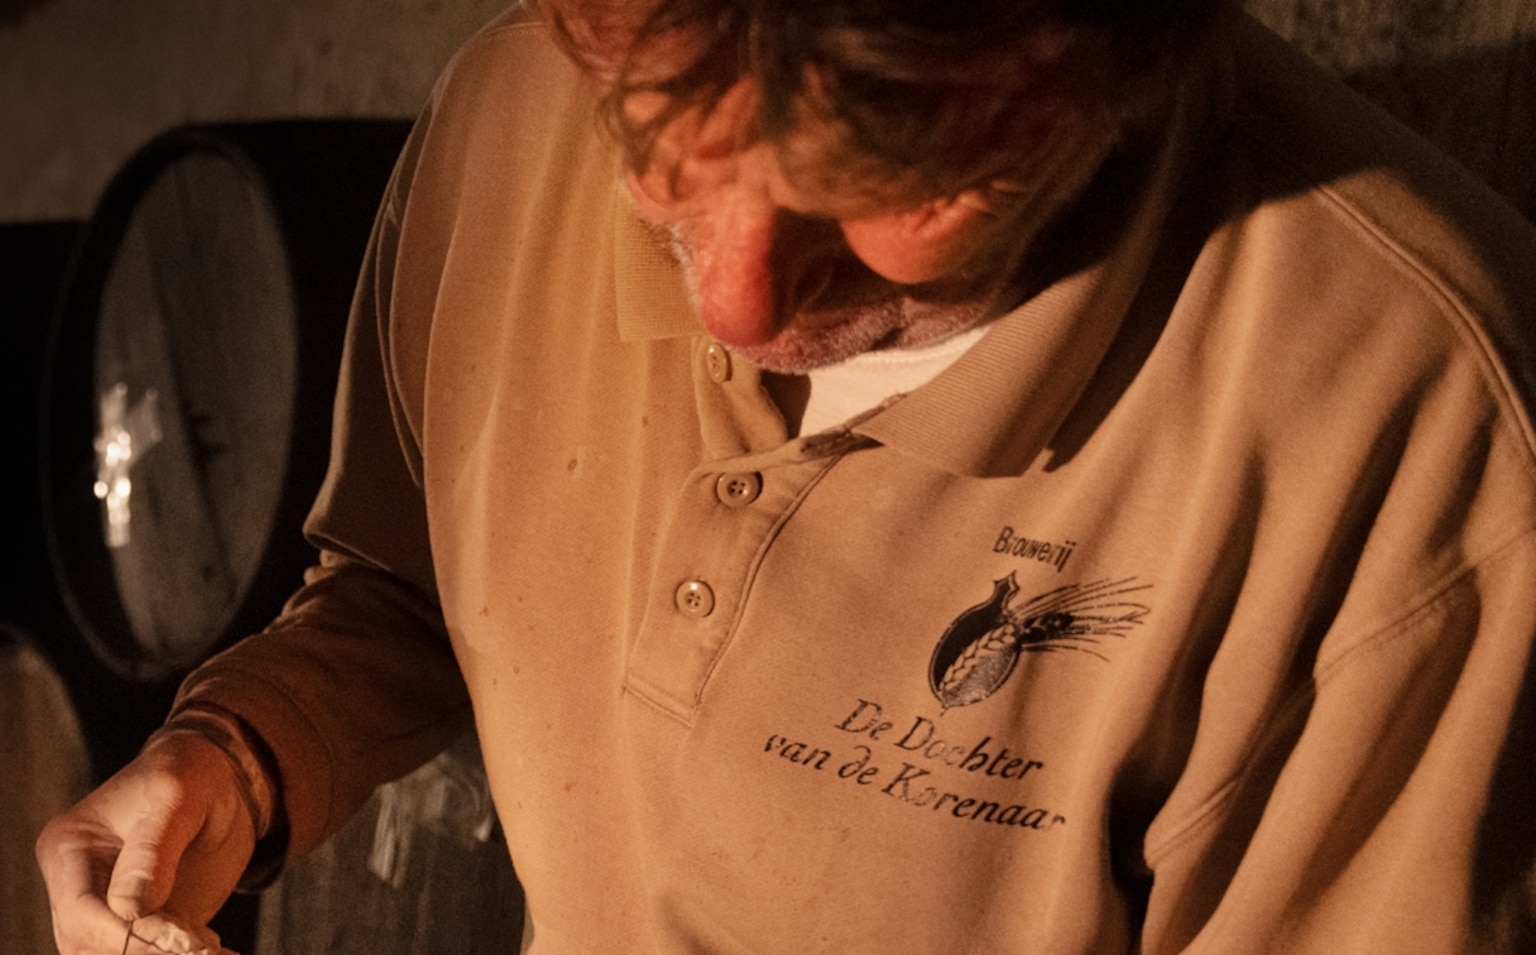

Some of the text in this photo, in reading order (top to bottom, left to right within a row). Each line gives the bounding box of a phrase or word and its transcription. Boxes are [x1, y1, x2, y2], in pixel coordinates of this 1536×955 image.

[993, 526, 1076, 572] Brouwerij
[834, 699, 1043, 780] De Dochter
[764, 734, 1066, 831] van de Korenaar
